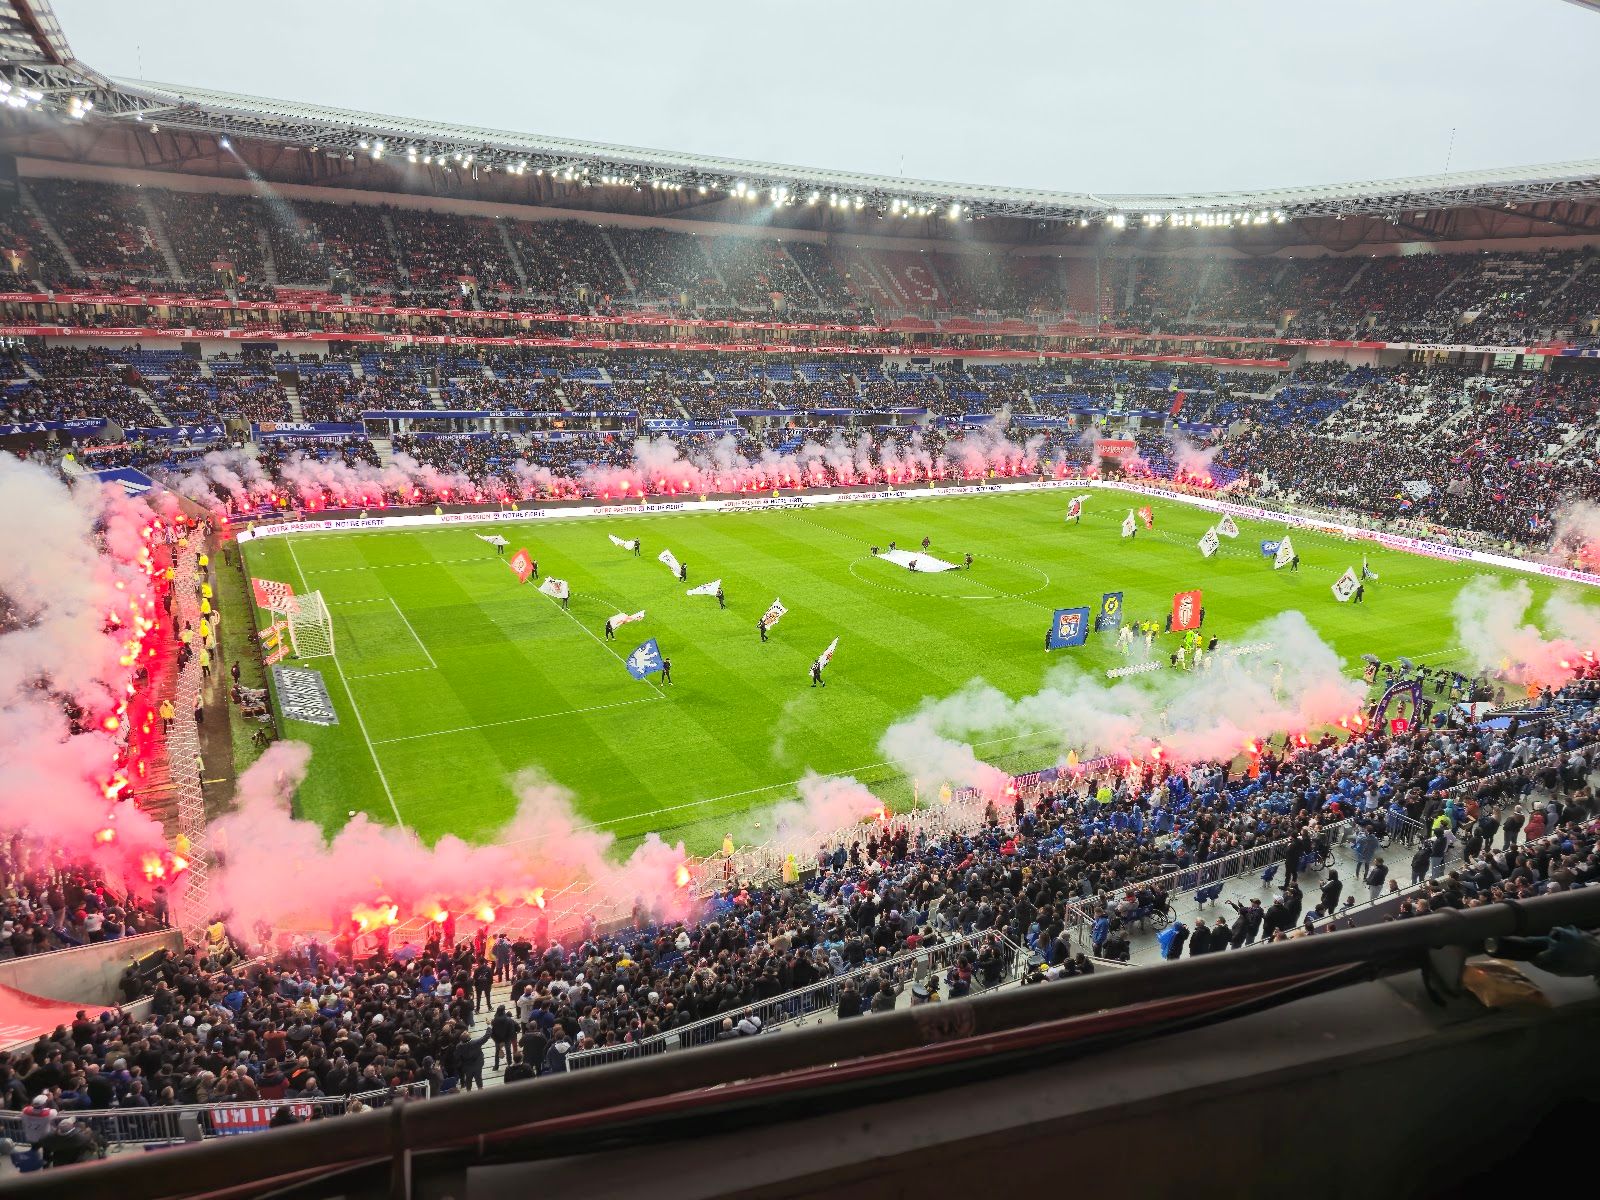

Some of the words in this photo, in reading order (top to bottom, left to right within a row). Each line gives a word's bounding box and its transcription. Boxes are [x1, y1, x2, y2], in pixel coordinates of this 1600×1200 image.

[266, 525, 288, 534] VOTRE
[290, 522, 321, 530] PASSION
[1356, 529, 1378, 539] VOTRE
[1380, 534, 1408, 545] PASSION
[1421, 542, 1446, 553] NOTRE
[1540, 566, 1568, 578] VOTRE
